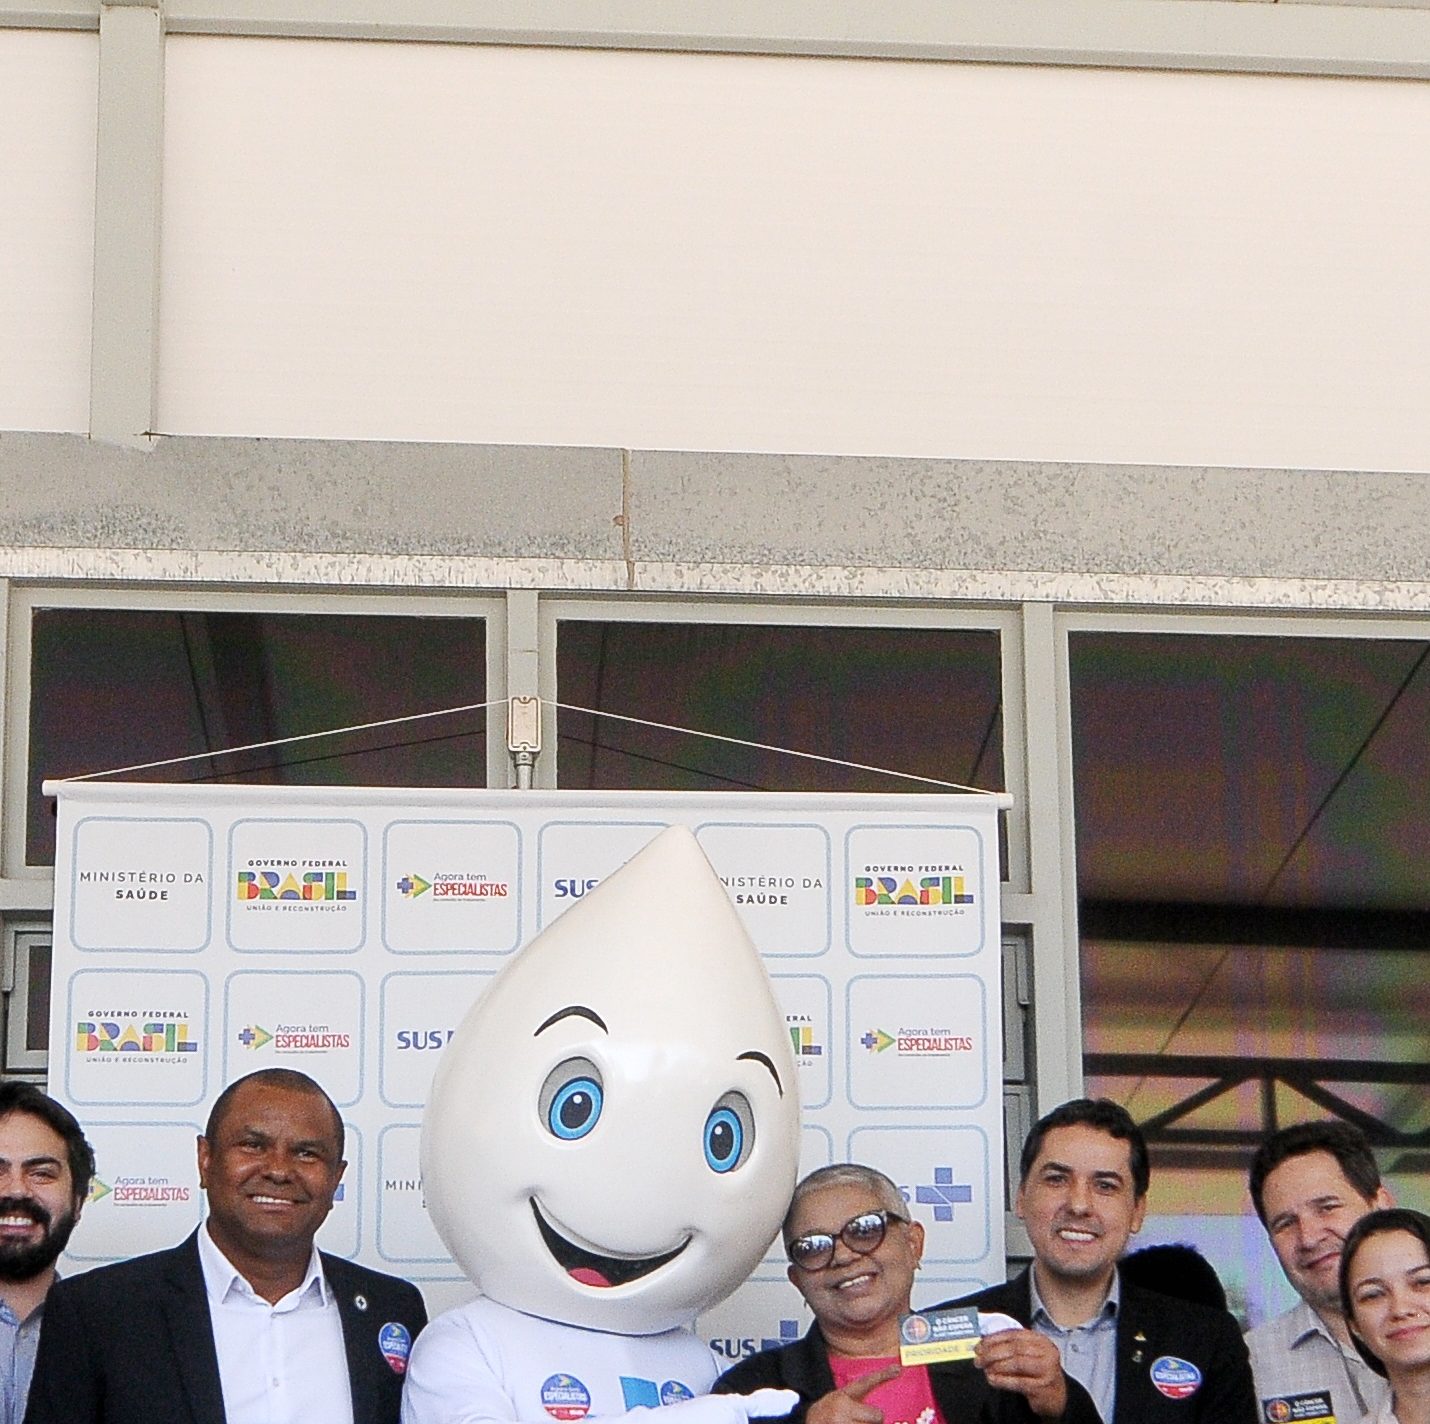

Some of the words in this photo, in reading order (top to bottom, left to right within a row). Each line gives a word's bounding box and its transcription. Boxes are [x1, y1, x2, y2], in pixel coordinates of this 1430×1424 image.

[247, 859, 298, 867] GOVERNO
[302, 859, 348, 867] FEDERAL
[864, 865, 914, 873] GOVERNO
[918, 864, 964, 872] FEDERAL
[79, 871, 176, 884] MINISTÉRIO
[183, 872, 205, 884] DA
[433, 872, 464, 882] Agora
[467, 873, 487, 881] tem
[720, 874, 796, 888] NISTÉRIO
[802, 877, 823, 889] DA
[237, 871, 357, 901] BRASIL
[433, 883, 508, 897] ESPECIALISTAS
[855, 876, 974, 905] BRASIL
[115, 887, 169, 901] SAÚDE
[736, 892, 788, 905] SAÚDE
[246, 904, 272, 912] UNIÃO
[282, 904, 347, 913] RECONSTRUÇÃO
[864, 909, 890, 917] UNIÃO
[900, 909, 965, 918] RECONSTRUÇÃO
[87, 1010, 138, 1018] GOVERNO
[275, 1024, 306, 1034] Agora
[309, 1024, 329, 1033] tem
[897, 1027, 928, 1037] Agora
[930, 1027, 951, 1036] tem
[76, 1022, 198, 1052] BRASIL
[275, 1034, 350, 1049] ESPECIALISTAS
[396, 1030, 443, 1050] SUS
[897, 1037, 973, 1051] ESPECIALISTAS
[114, 1176, 146, 1187] Agora
[148, 1177, 169, 1185] tem
[113, 1187, 190, 1201] ESPECIALISTAS
[710, 1338, 755, 1359] SUS
